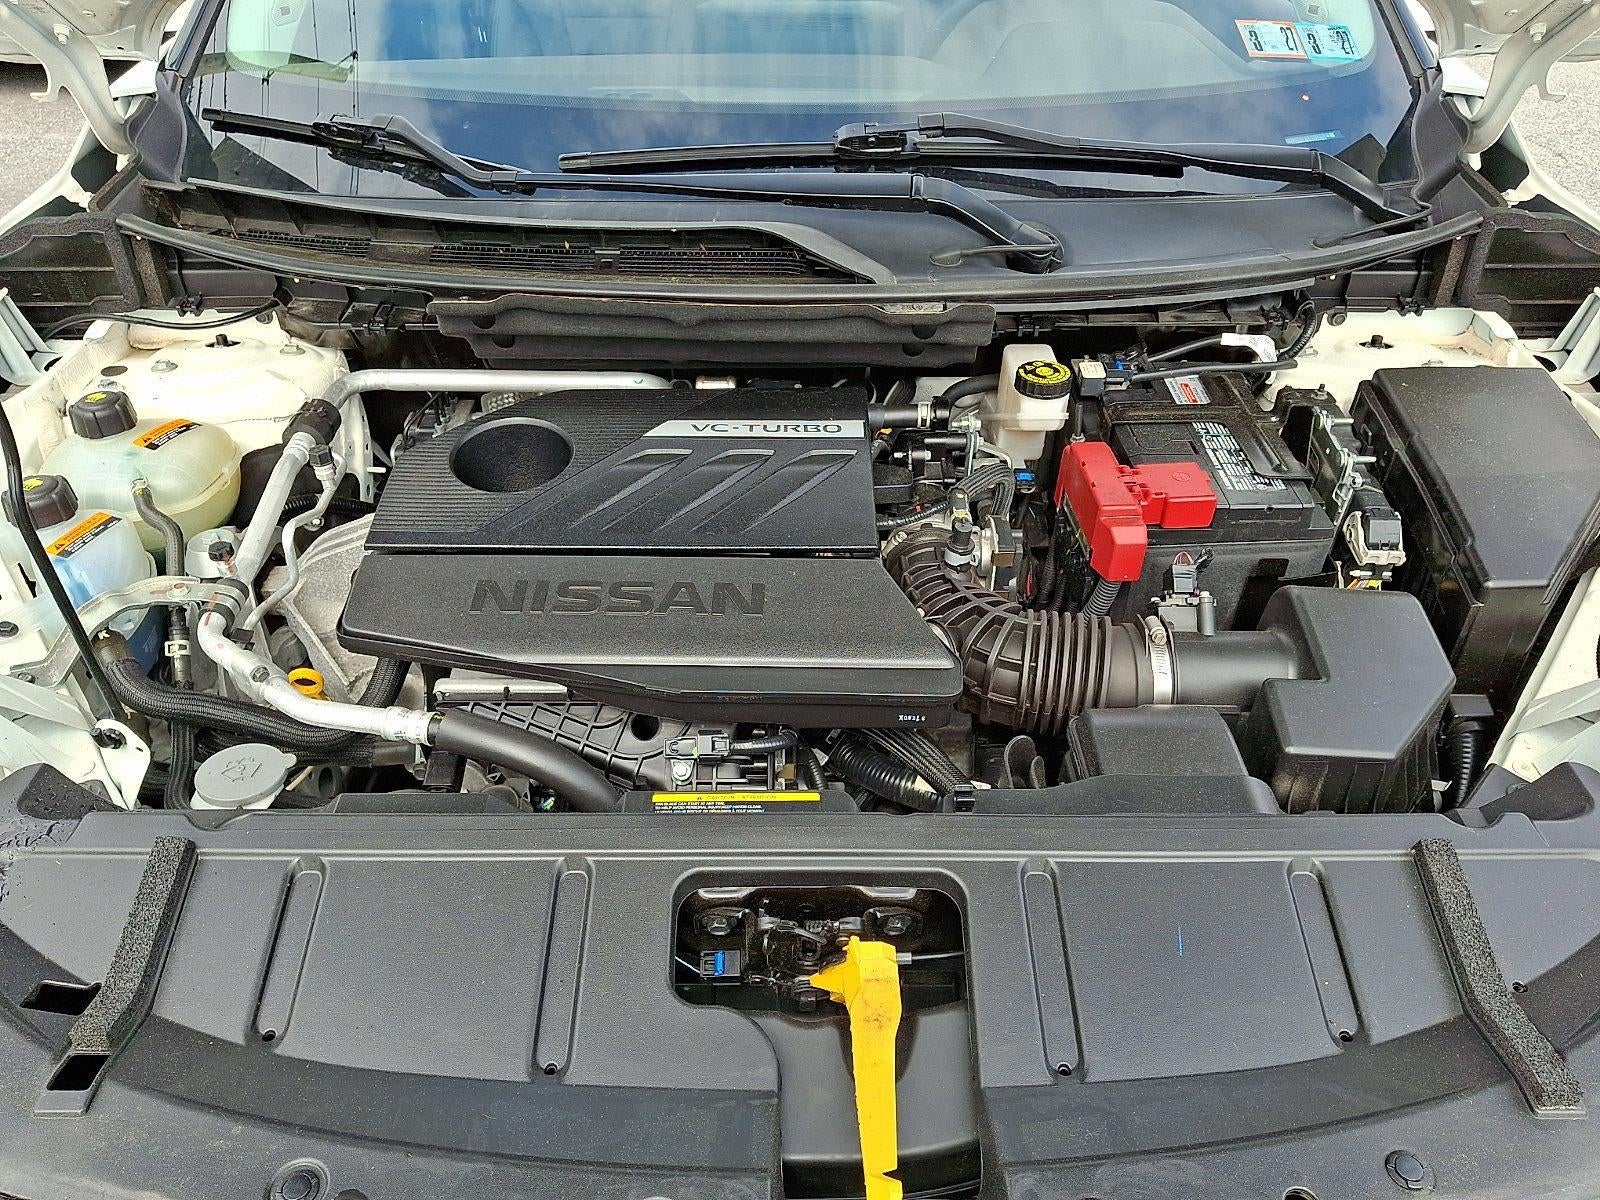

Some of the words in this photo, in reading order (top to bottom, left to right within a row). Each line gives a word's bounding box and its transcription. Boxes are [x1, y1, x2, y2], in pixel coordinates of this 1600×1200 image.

[1248, 30, 1263, 51] 3
[1307, 33, 1322, 54] 3
[690, 423, 842, 434] VC-TURBO
[468, 578, 766, 617] NISSAN
